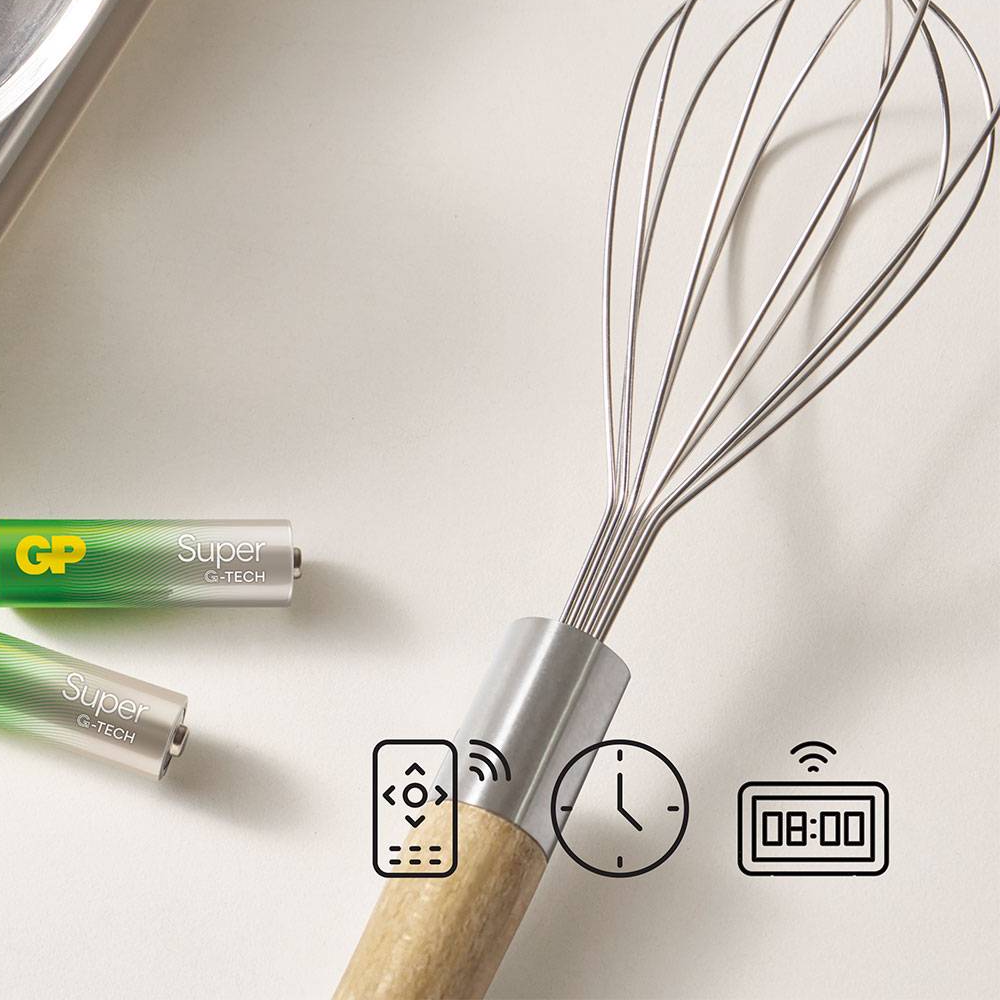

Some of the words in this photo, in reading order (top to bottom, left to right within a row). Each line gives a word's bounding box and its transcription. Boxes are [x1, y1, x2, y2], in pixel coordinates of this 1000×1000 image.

[15, 535, 86, 575] GP
[177, 534, 266, 568] Super
[204, 569, 266, 584] G-TECH
[61, 672, 149, 724] Super
[76, 713, 136, 745] G-TECH
